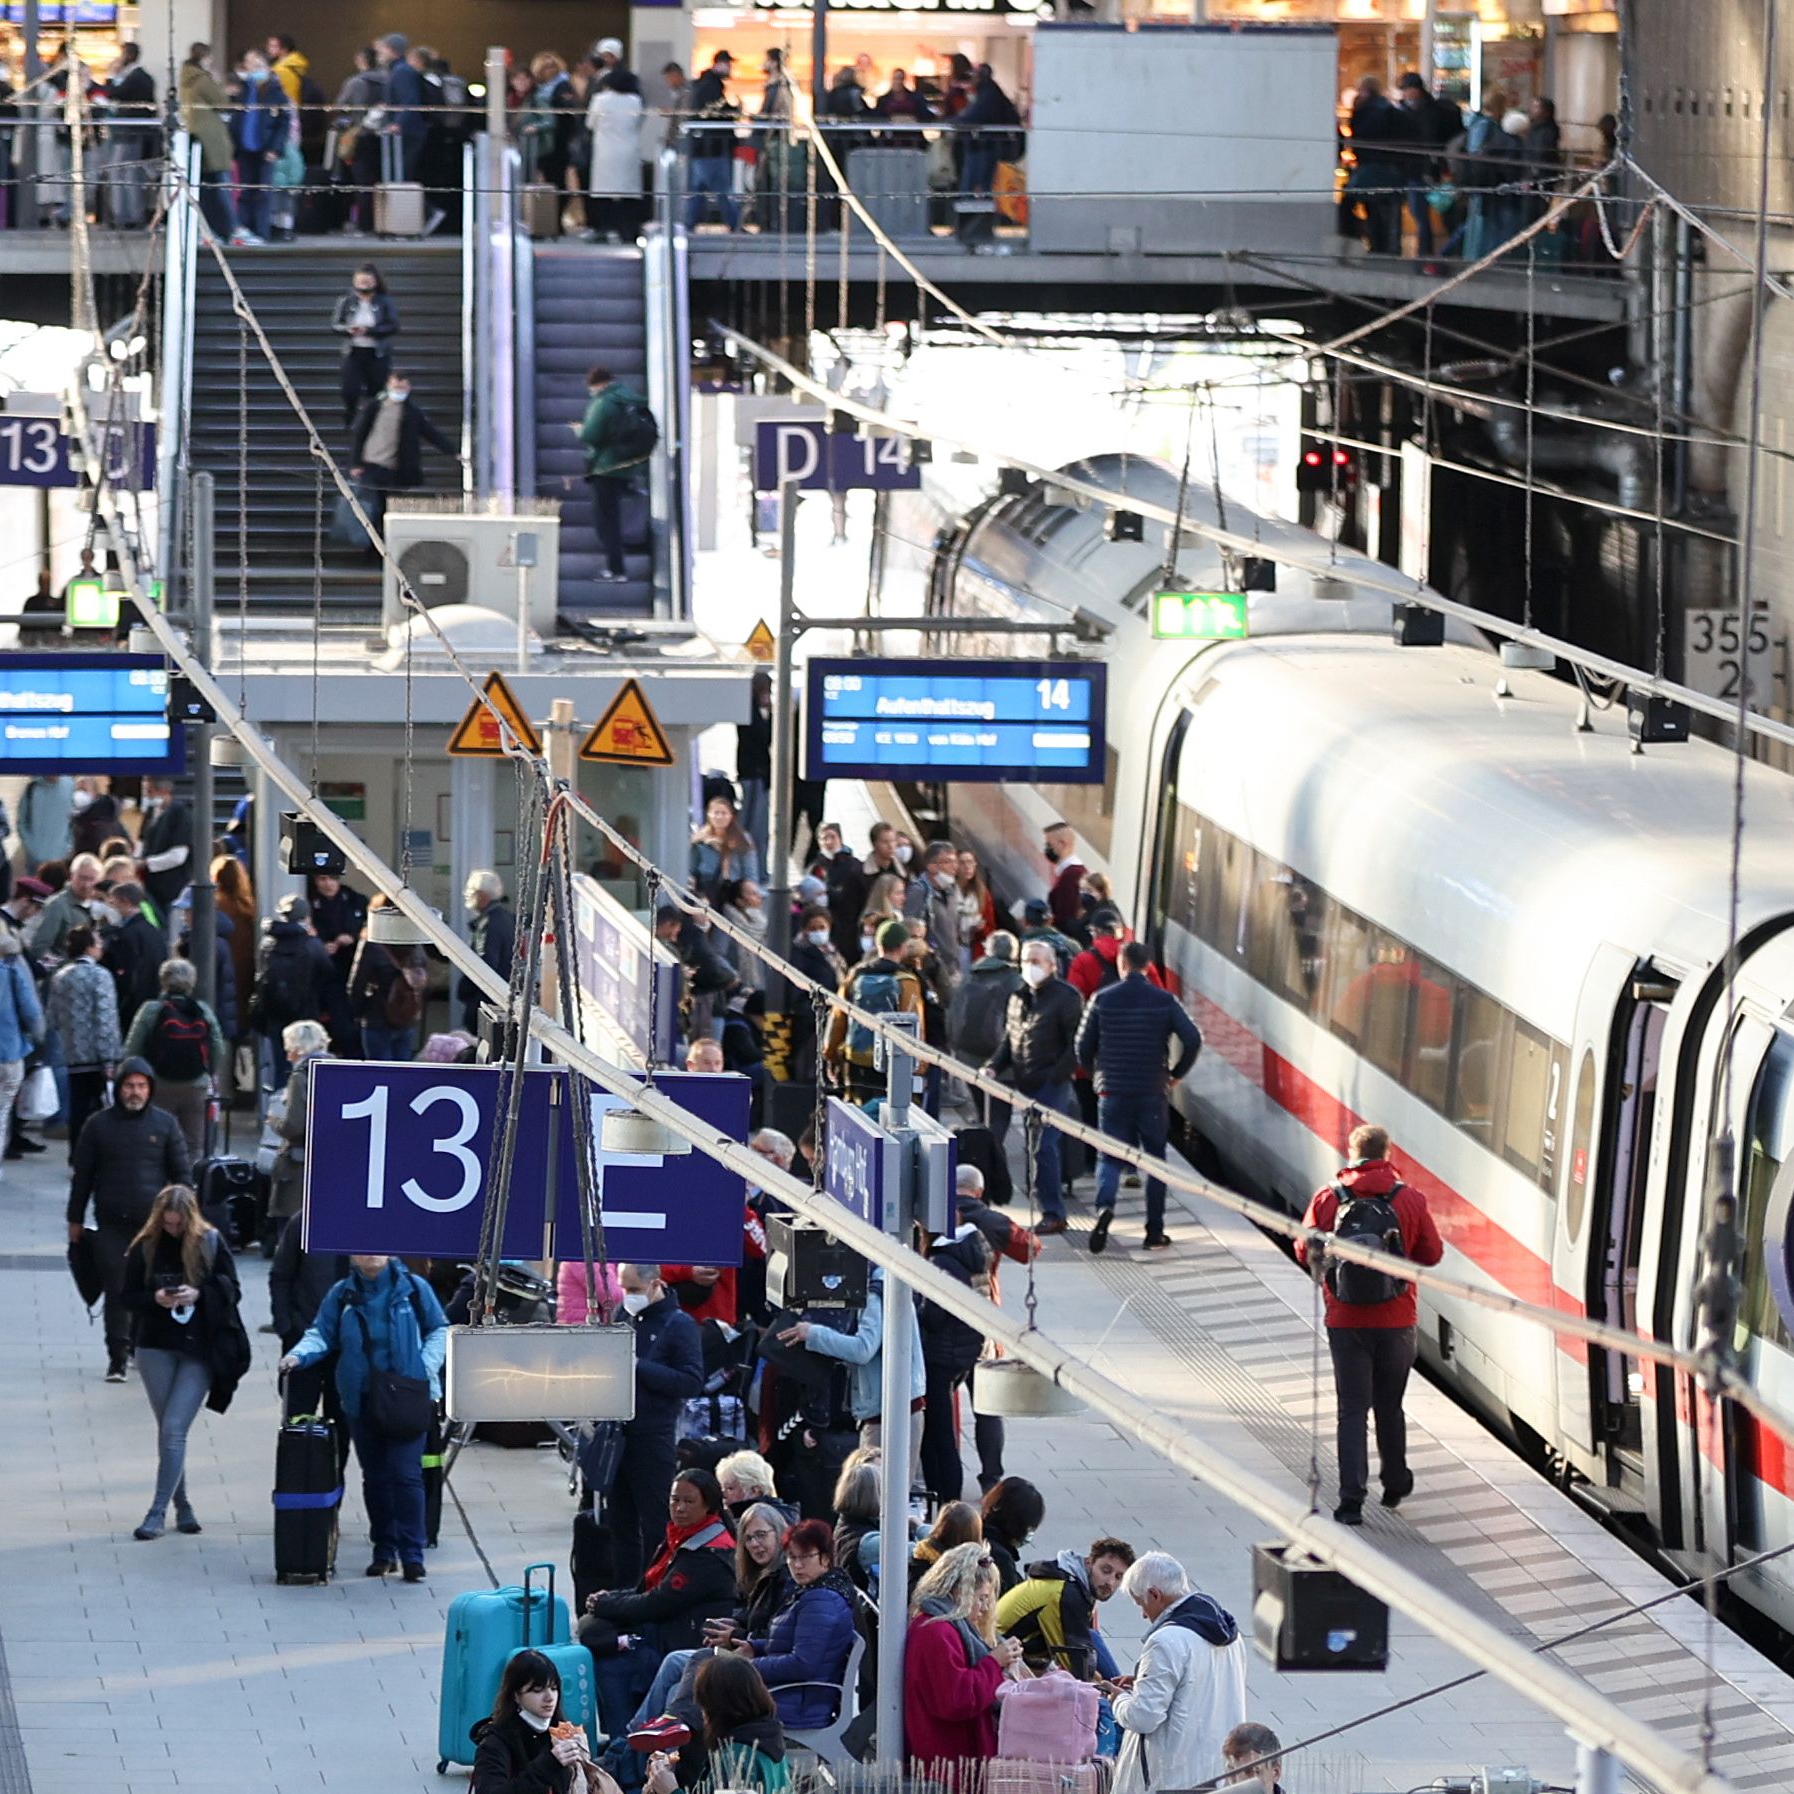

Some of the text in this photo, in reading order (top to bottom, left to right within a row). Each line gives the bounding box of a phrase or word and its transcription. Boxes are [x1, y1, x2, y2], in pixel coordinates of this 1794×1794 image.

[0, 421, 58, 473] 13
[777, 426, 908, 482] D 14
[1692, 614, 1770, 654] 355
[1037, 679, 1070, 709] 14
[1718, 659, 1741, 699] 2
[341, 1084, 670, 1229] 13 E
